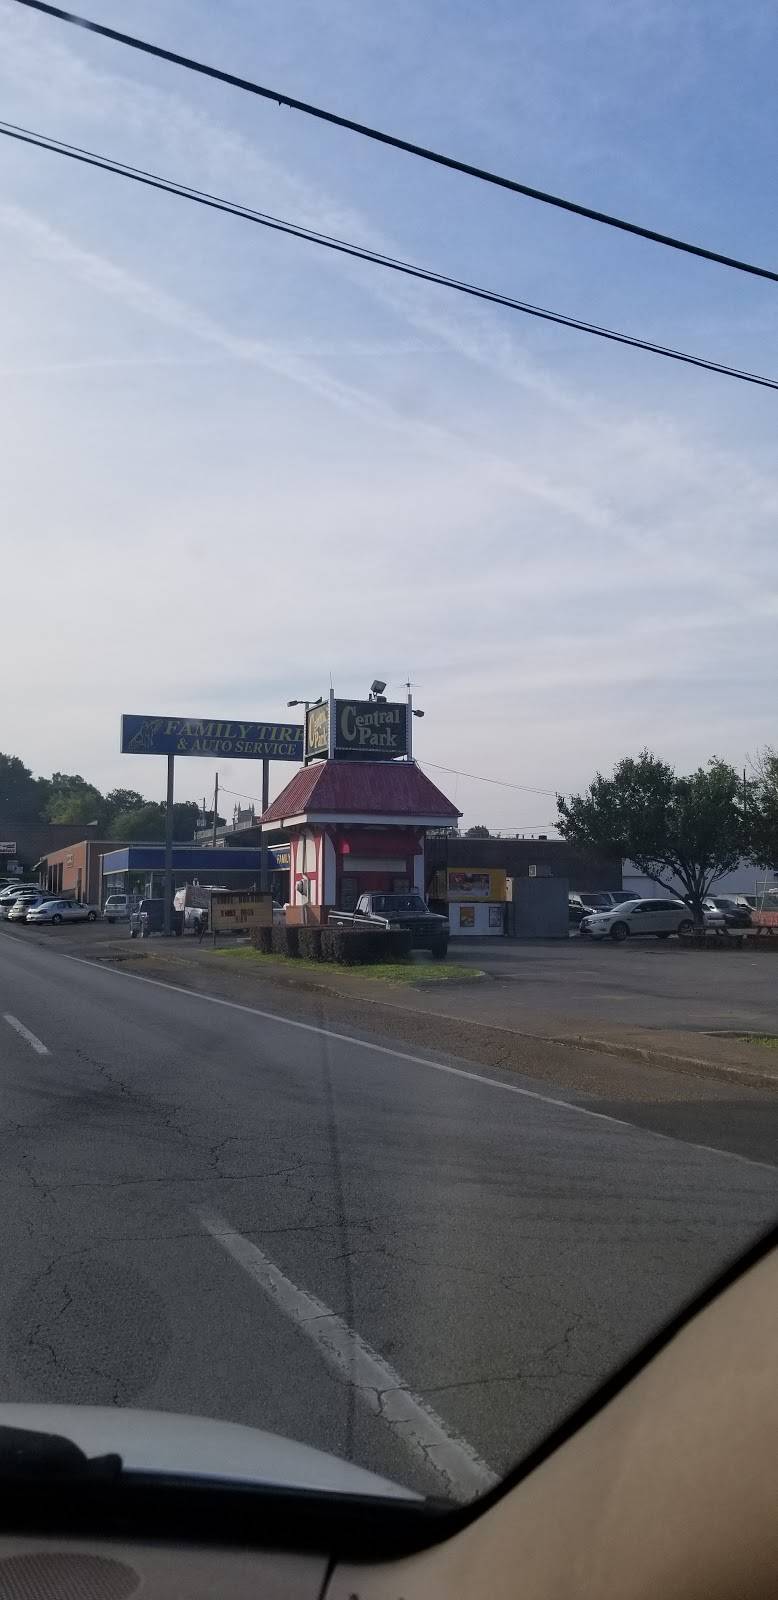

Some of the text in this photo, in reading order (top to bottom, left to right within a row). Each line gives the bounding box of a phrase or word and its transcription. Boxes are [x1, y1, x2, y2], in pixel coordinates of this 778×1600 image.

[163, 719, 254, 740] FAMILY
[341, 705, 400, 741] Central
[177, 738, 297, 756] & AUTO SERVICE
[358, 727, 399, 747] Park
